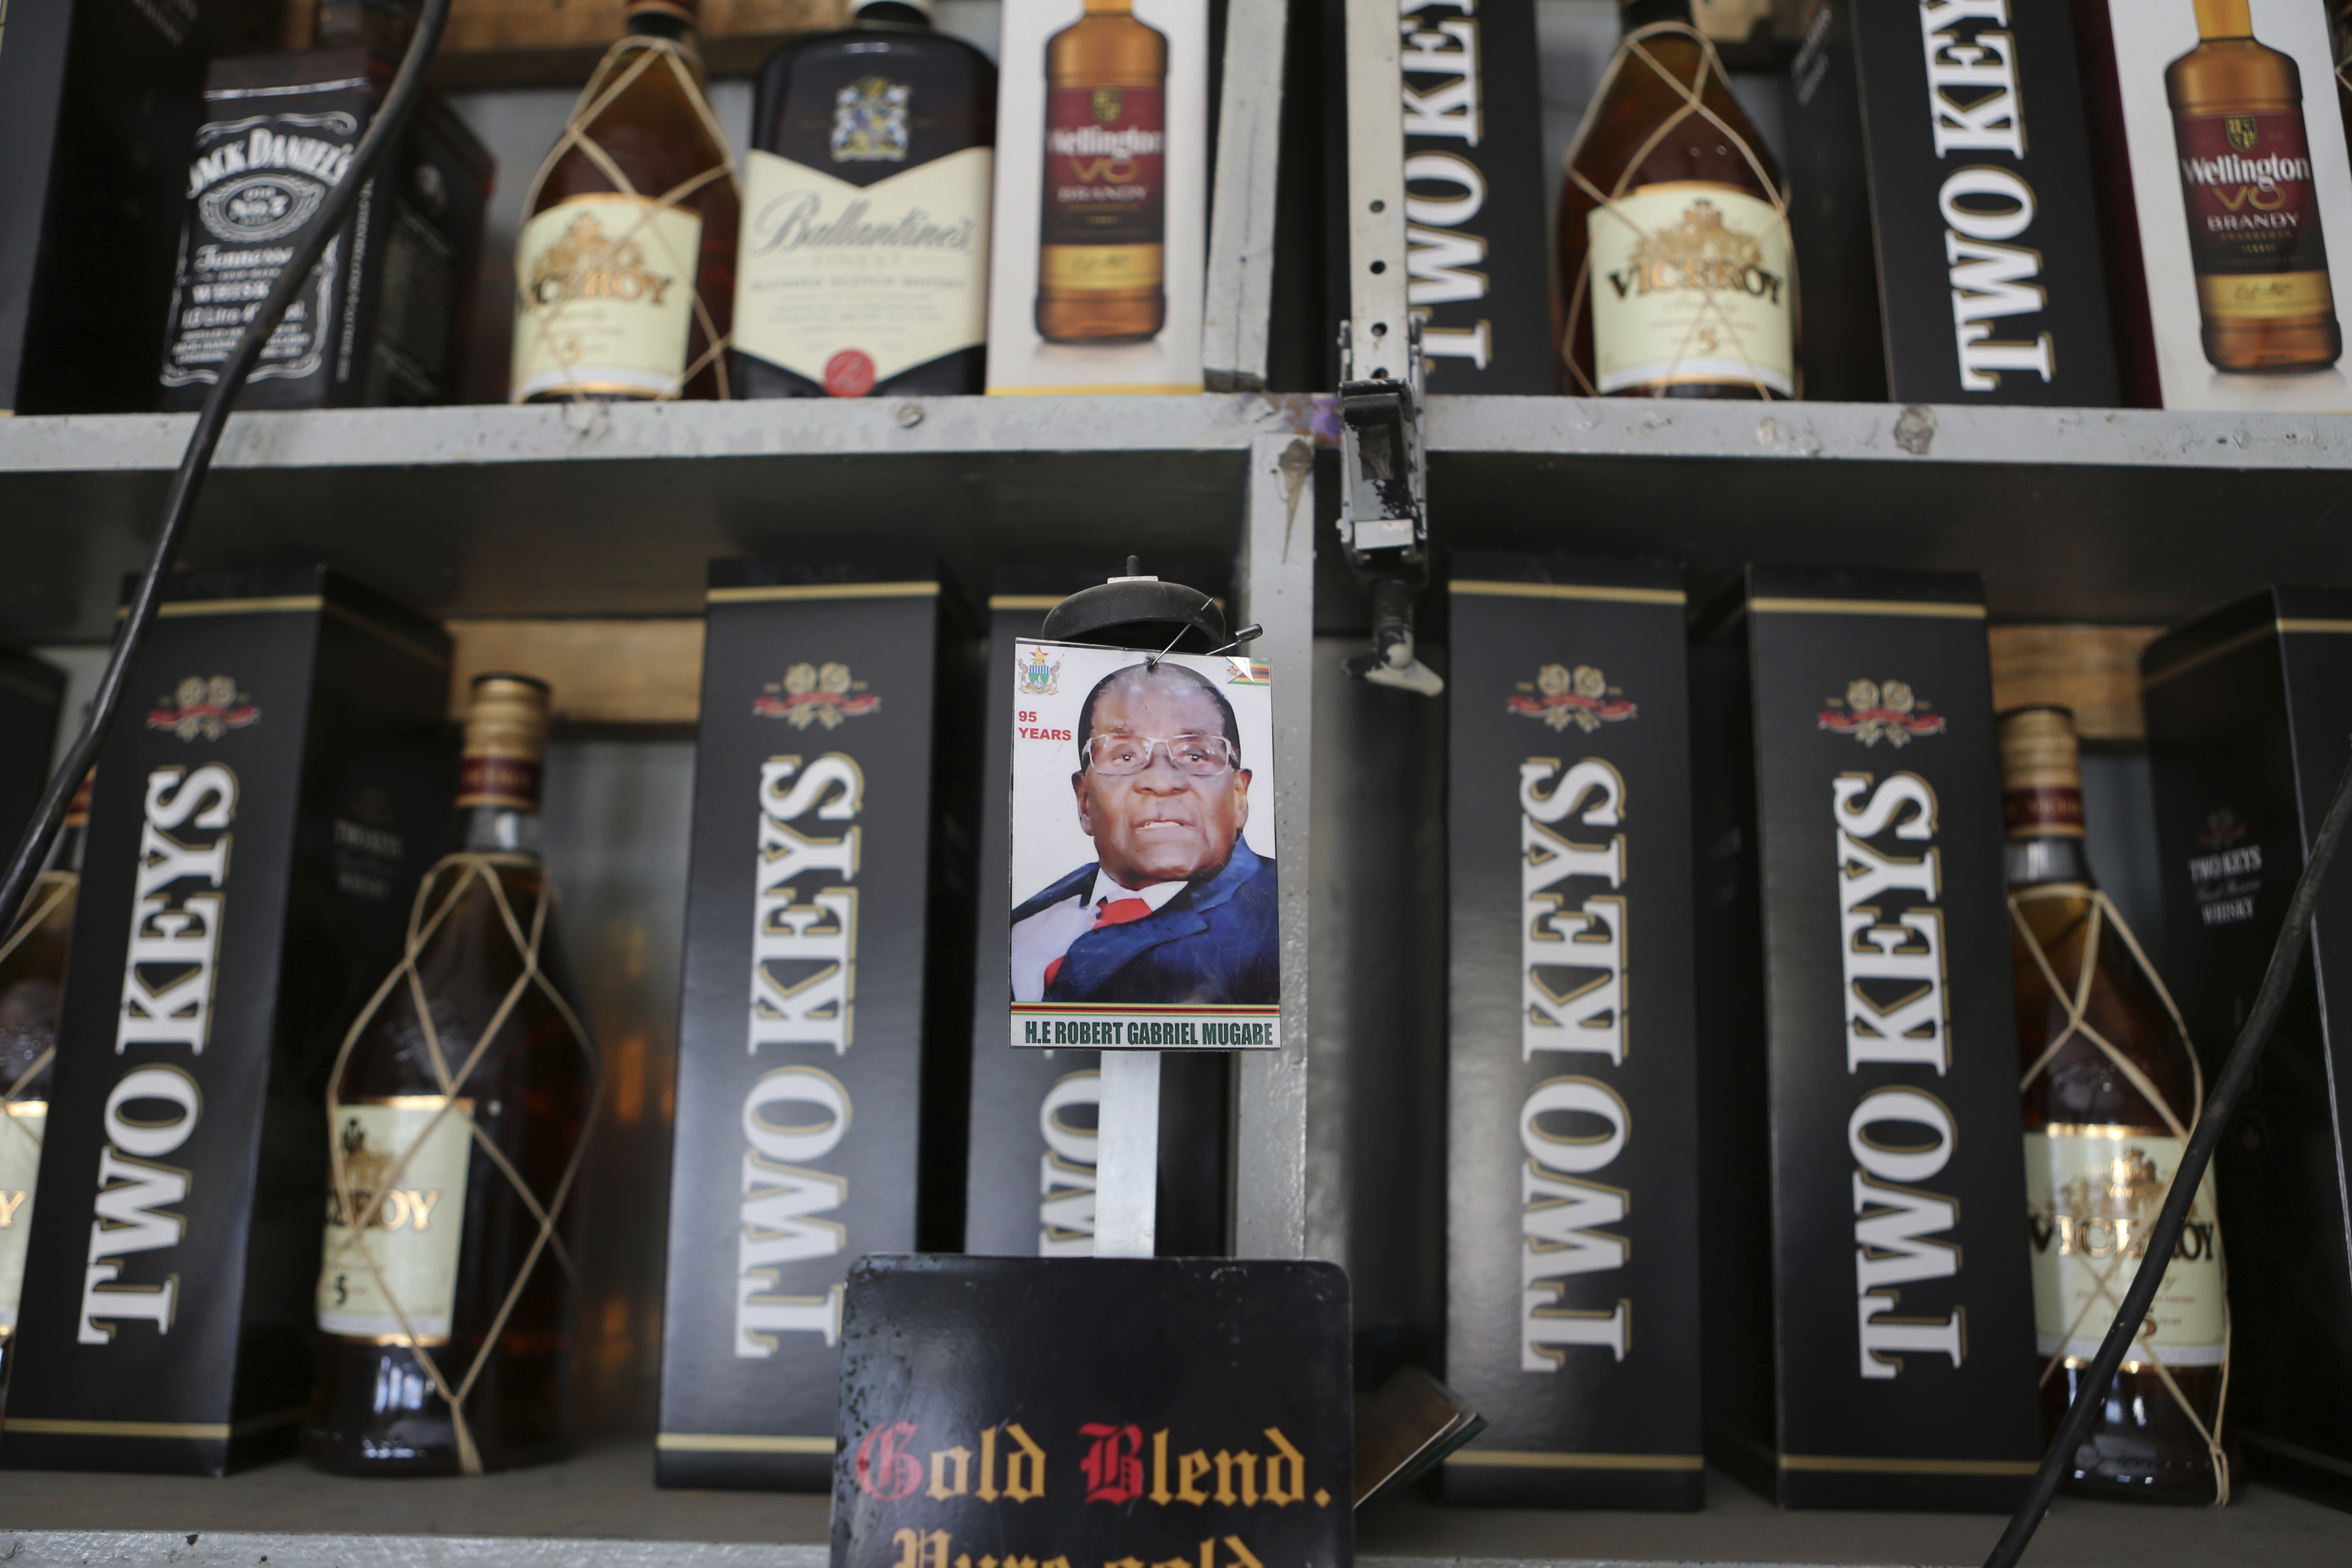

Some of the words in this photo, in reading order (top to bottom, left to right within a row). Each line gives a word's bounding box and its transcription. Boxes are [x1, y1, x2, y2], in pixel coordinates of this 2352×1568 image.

[185, 139, 247, 200] JACK
[1068, 157, 1140, 184] VO
[2181, 151, 2311, 193] Wellington
[2210, 186, 2285, 211] VO
[748, 188, 976, 259] Ballantine's
[2207, 211, 2300, 232] BRANDY
[1608, 258, 1782, 306] VICEROY
[1938, 164, 2055, 392] TWO
[1018, 727, 1072, 741] YEARS
[1019, 711, 1037, 722] 95
[115, 762, 239, 1055] KEYS
[748, 751, 865, 1056] KEYS
[1519, 757, 1628, 1066] KEYS
[1833, 770, 1952, 1077] KEYS
[1025, 1021, 1050, 1044] H.E
[1055, 1022, 1123, 1044] ROBERT
[1127, 1022, 1198, 1045] GABRIEL
[1202, 1023, 1273, 1045] MUGABE
[78, 1063, 203, 1345] TWO
[735, 1065, 853, 1358] TWO
[1519, 1074, 1631, 1372] TWO
[1847, 1084, 1967, 1379] TWO
[2029, 1214, 2215, 1261] VICEOY
[334, 1273, 348, 1307] 5
[856, 1421, 1047, 1503] Gold
[1078, 1422, 1331, 1507] Blend.
